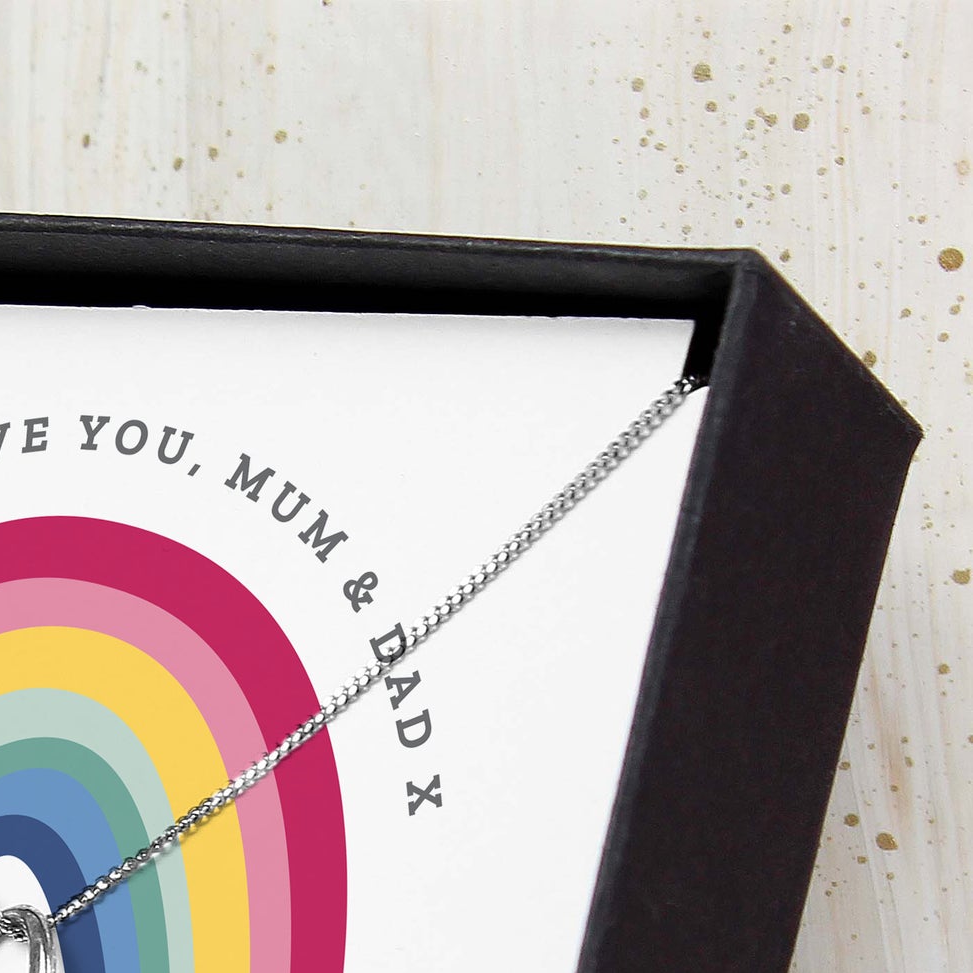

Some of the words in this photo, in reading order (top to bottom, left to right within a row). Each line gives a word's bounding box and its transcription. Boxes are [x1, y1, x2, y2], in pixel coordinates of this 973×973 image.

[79, 414, 202, 477] YOU,
[223, 452, 349, 564] MUM
[342, 571, 379, 613] &
[369, 622, 432, 749] DAD
[405, 774, 443, 817] X
